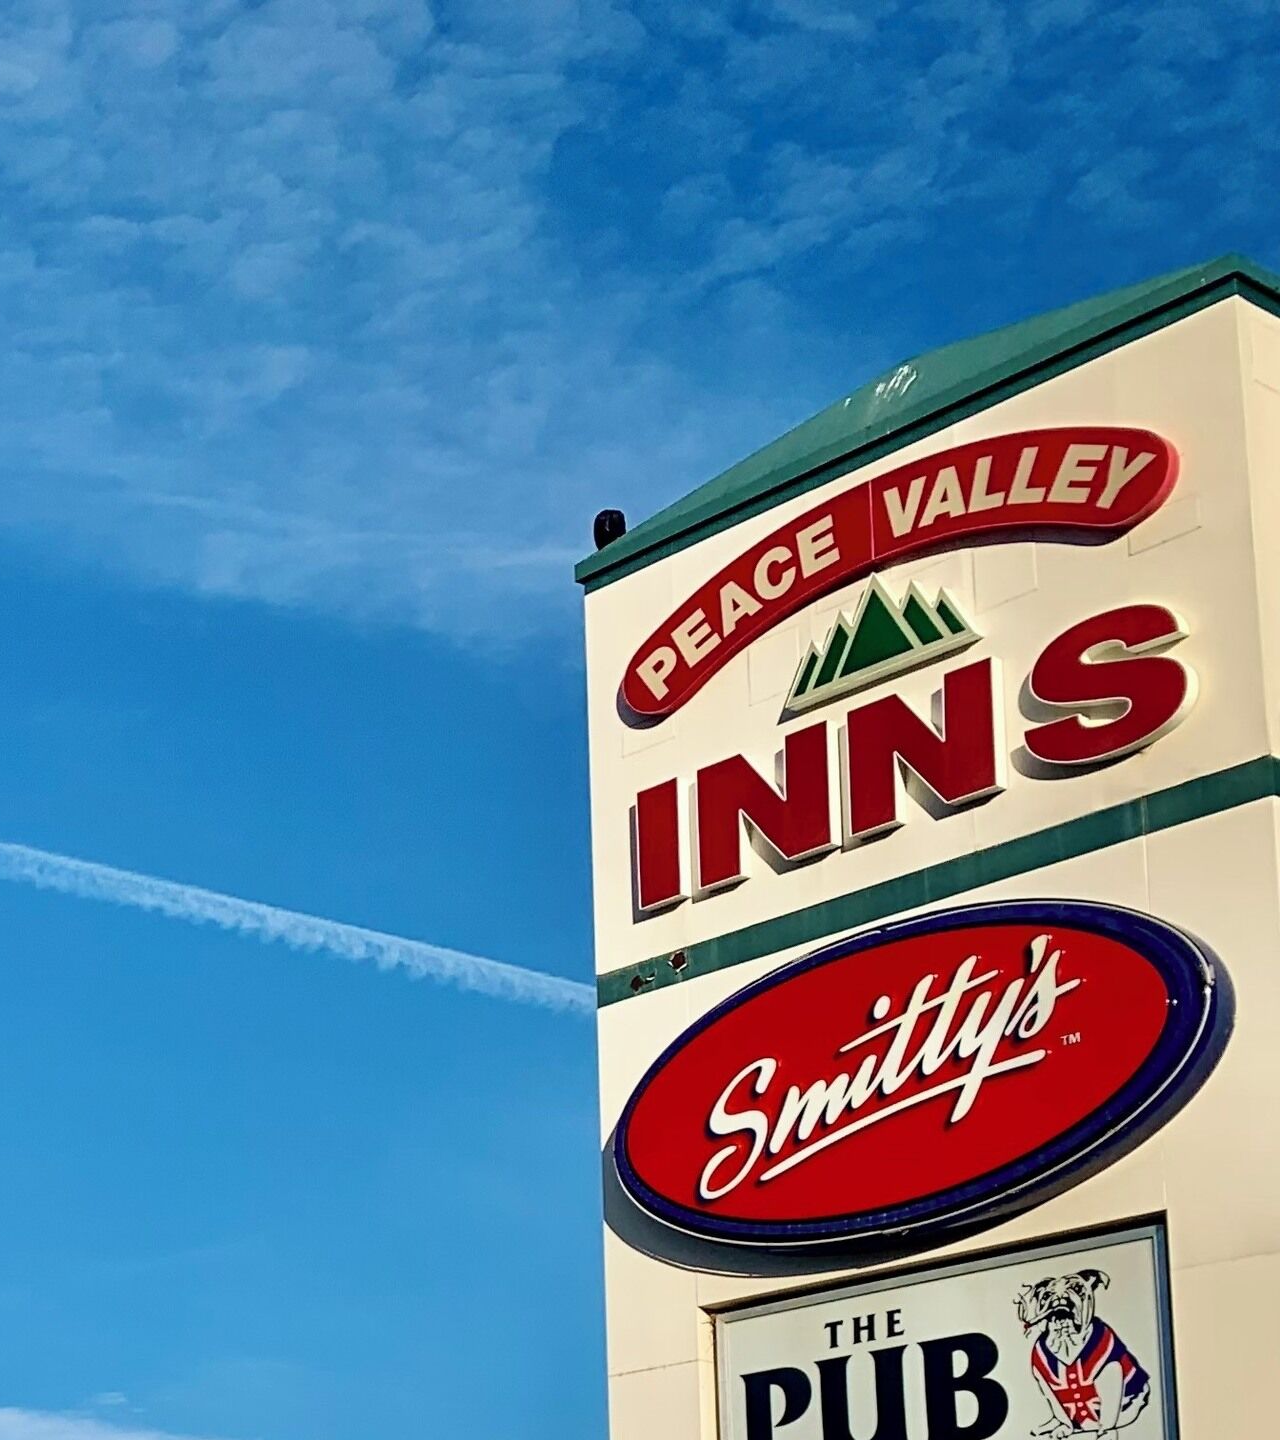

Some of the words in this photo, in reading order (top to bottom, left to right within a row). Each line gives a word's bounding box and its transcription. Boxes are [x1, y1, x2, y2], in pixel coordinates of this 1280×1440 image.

[635, 514, 841, 702] PEACE
[883, 443, 1157, 538] VALLEY
[635, 603, 1195, 912] INNS
[698, 933, 1082, 1201] Smitty's
[1060, 1031, 1081, 1046] TM
[823, 1307, 906, 1349] THE
